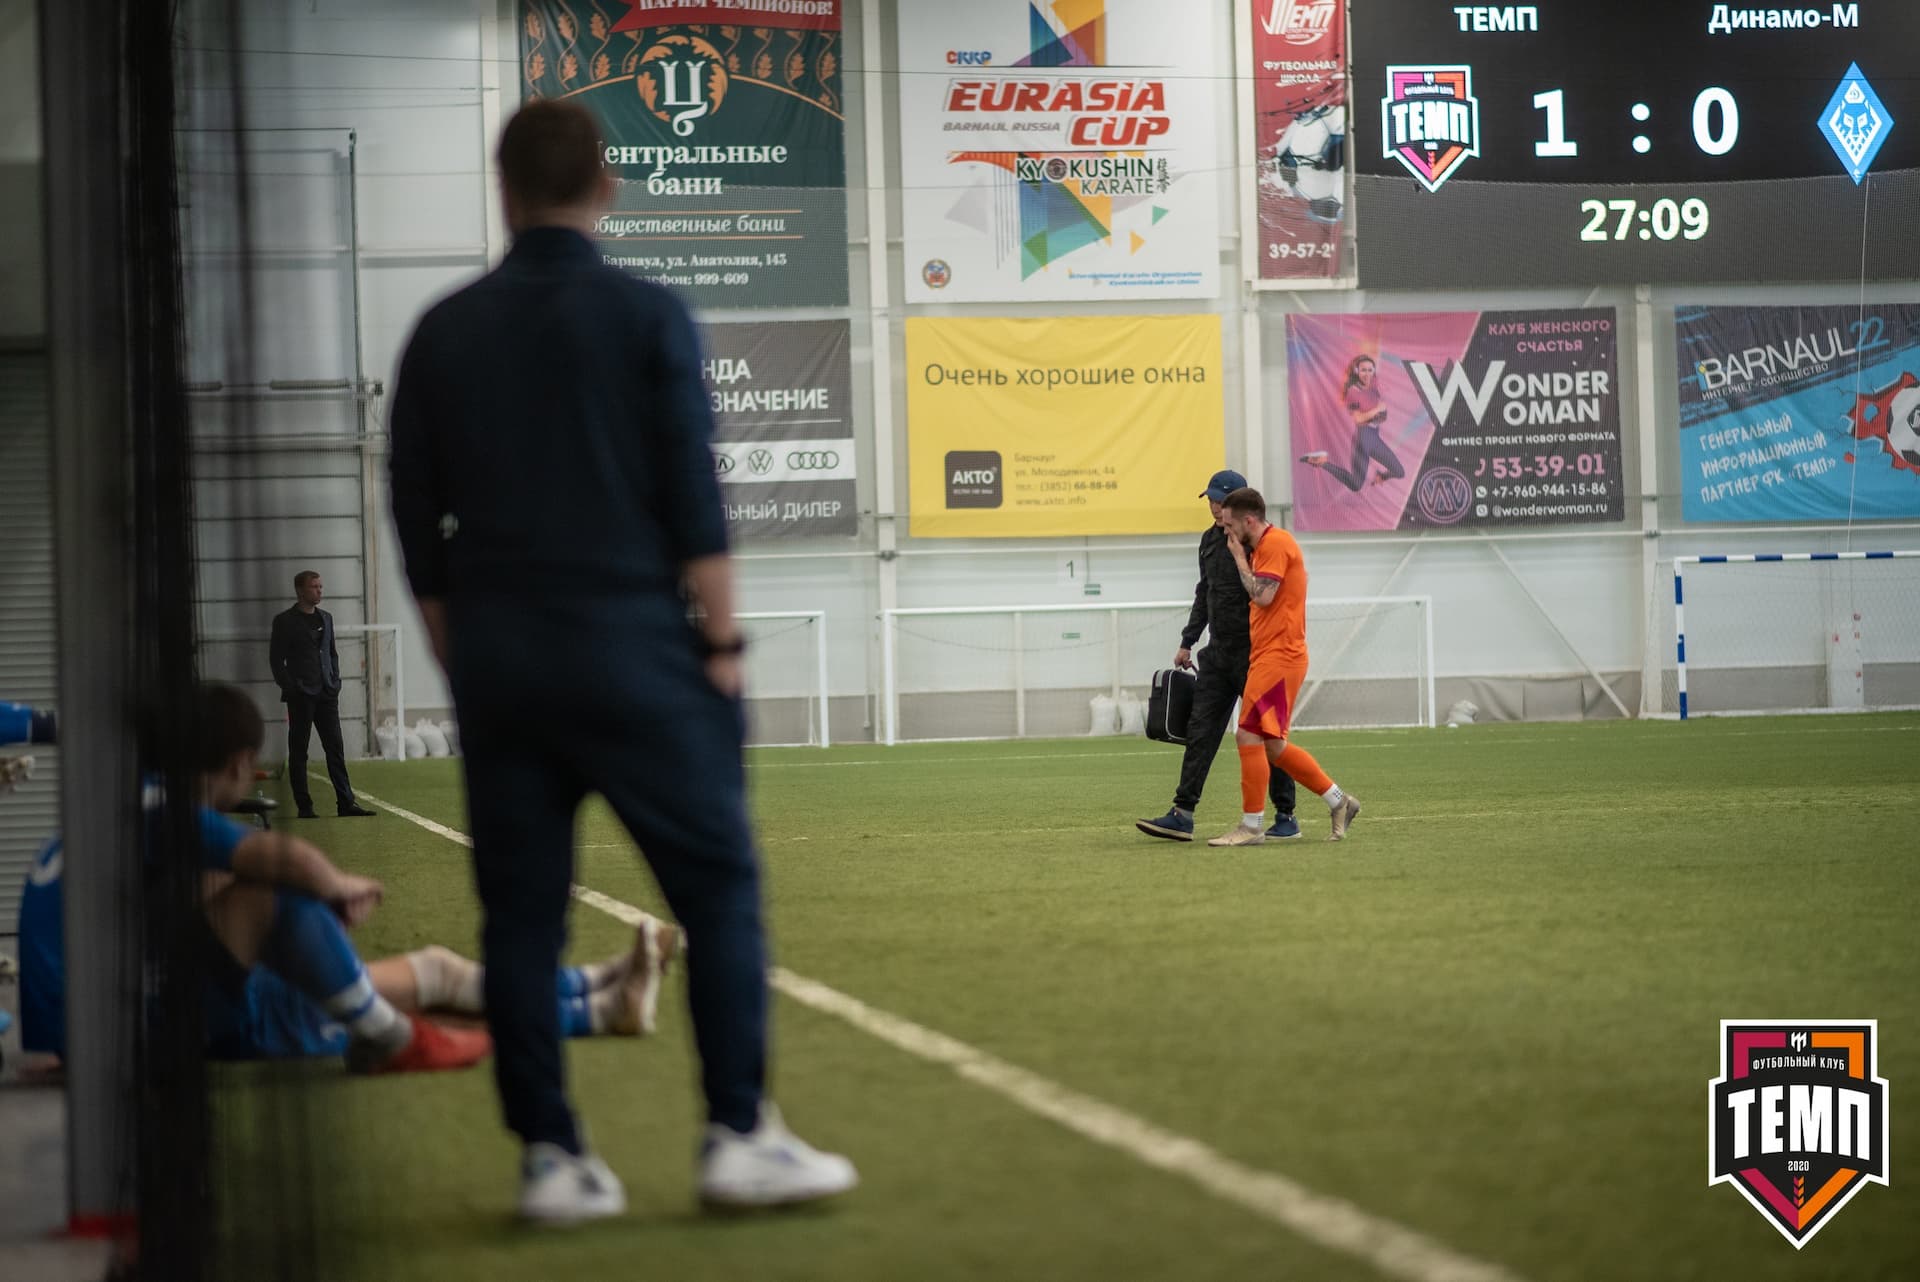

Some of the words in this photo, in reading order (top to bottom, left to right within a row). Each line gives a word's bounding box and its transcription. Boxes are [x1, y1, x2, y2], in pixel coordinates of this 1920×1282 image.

[1453, 6, 1538, 31] ТЕМП
[1708, 3, 1859, 34] Динамо-М
[1280, 74, 1320, 84] ШКОЛА
[947, 80, 1166, 112] EURASIA
[943, 122, 1008, 131] BARNAUL
[1012, 122, 1061, 131] RUSSIA
[1070, 116, 1171, 146] CUP
[1391, 101, 1470, 144] ТЕМП
[1533, 88, 1578, 157] 1
[1692, 86, 1740, 156] 0
[598, 141, 788, 171] ентральные
[647, 170, 724, 196] бани
[1081, 178, 1154, 194] KARATE
[736, 214, 786, 234] бани
[1580, 198, 1710, 242] 27:09
[694, 272, 749, 286] 999-609
[1488, 323, 1526, 335] КЛУБ
[1529, 320, 1611, 334] ЖЕНСКОГО
[1516, 340, 1583, 353] СЧАСТЬЯ
[924, 363, 1009, 386] Очень
[1016, 366, 1135, 391] хорошие
[1143, 364, 1207, 384] окна
[711, 387, 830, 414] ЗНАЧЕНИЕ
[1441, 436, 1483, 447] ФИТНЕС
[1485, 435, 1523, 445] ПРОЕКТ
[1526, 433, 1566, 444] НОВОГО
[1568, 431, 1616, 442] ФОРМАТА
[1699, 412, 1793, 452] ГЕНЕРАЛЬНЫЙ
[1492, 453, 1606, 479] 53-39-01
[1700, 430, 1828, 479] ИНФОРМАЦИОННЫЙ
[952, 470, 995, 485] АКТО
[1700, 474, 1759, 505] ПАРТНЕР
[1762, 468, 1785, 488] ФК
[1492, 483, 1607, 499] +7-960-944-15-86
[782, 500, 842, 522] ДИЛЕР
[1492, 502, 1608, 518] @wonderwoman.ru
[1066, 560, 1075, 578] 1
